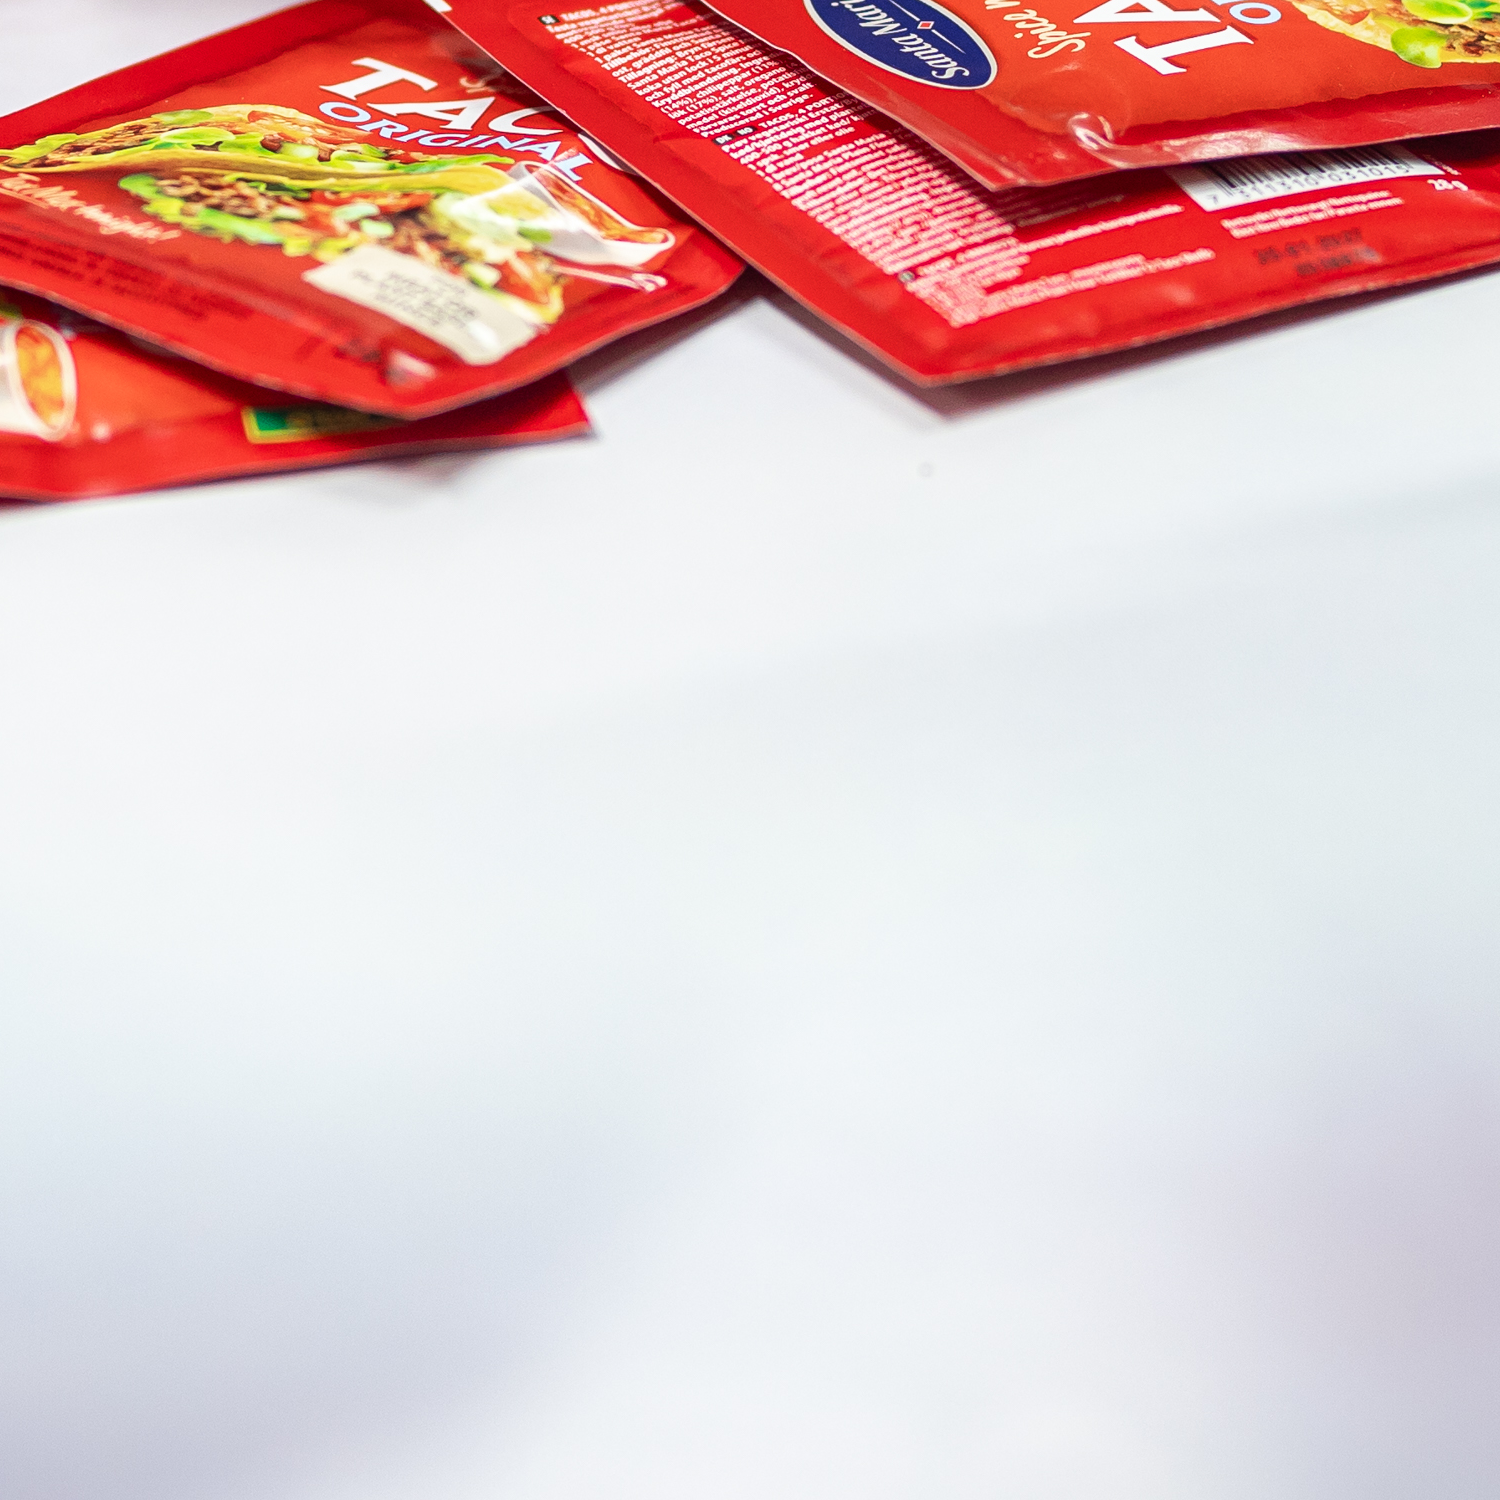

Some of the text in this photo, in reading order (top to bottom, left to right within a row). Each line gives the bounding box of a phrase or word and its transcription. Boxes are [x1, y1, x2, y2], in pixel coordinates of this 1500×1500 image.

[891, 32, 970, 79] Santa
[1003, 8, 1091, 59] Spice
[599, 45, 656, 70] Tillbehör:
[608, 65, 633, 76] ost,
[629, 46, 673, 68] gräddfil
[669, 40, 692, 51] och
[616, 54, 680, 83] Tillagning:
[674, 45, 703, 58] Bryn
[624, 72, 660, 89] Santa
[655, 59, 689, 76] Maria
[684, 49, 713, 62] Taco
[709, 40, 741, 54] Spice
[633, 81, 663, 95] koka
[658, 70, 688, 84] utan
[683, 60, 709, 72] lock
[642, 89, 665, 101] och
[660, 81, 682, 93] fyll
[678, 70, 706, 85] med
[702, 54, 747, 74] tacofärs
[650, 65, 743, 107] Kryddblandning.
[658, 95, 697, 113] (14%),
[692, 69, 753, 98] chilipeppar
[666, 108, 688, 118] lök
[683, 94, 723, 112] (17%),
[718, 83, 745, 97] salt,
[741, 66, 788, 86] oregano
[675, 86, 763, 124] potatisstärkelse,
[683, 113, 720, 129] medel
[716, 85, 786, 116] (kiseldioxid),
[690, 80, 818, 133] Förvaras torrt och svalt.
[319, 57, 614, 170] TAC
[699, 111, 764, 137] Producerad
[765, 92, 816, 113] Sverige.
[735, 126, 755, 135] NO
[756, 111, 800, 128] TACOS,
[801, 116, 830, 129] med
[318, 102, 594, 182] ORIGINAL
